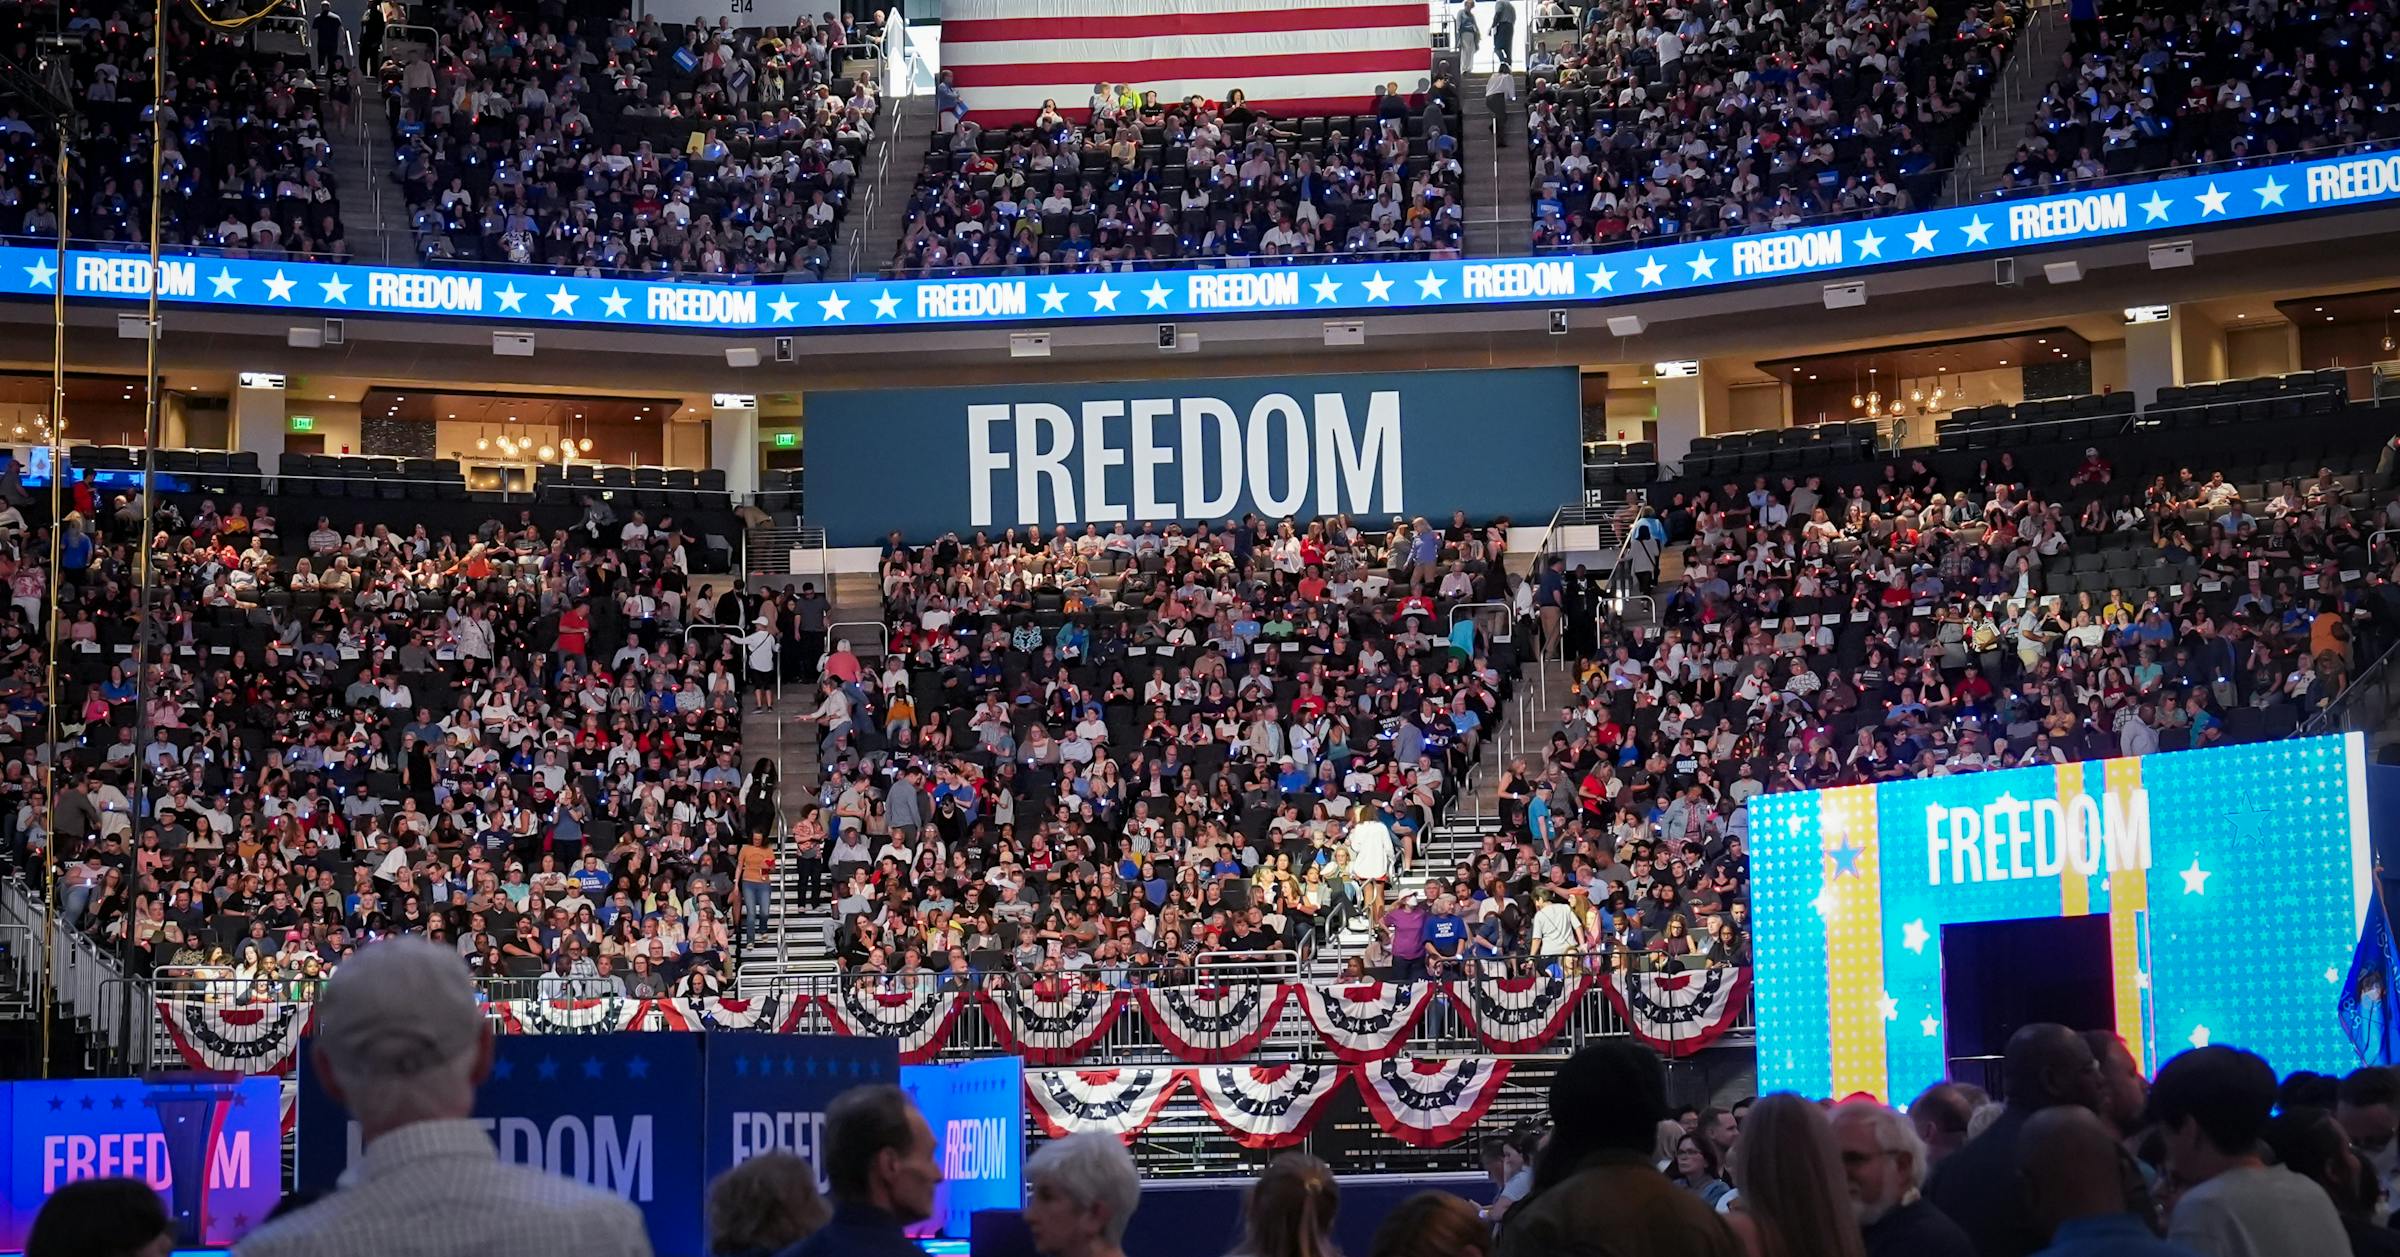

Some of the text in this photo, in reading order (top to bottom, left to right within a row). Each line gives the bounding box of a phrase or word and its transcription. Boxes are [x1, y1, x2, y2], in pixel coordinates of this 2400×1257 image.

[731, 0, 753, 13] 214
[2010, 193, 2127, 241] FREEDOM
[1733, 230, 1842, 276] FREEDOM
[76, 256, 196, 296] FREEDOM
[369, 272, 482, 311] FREEDOM
[1188, 271, 1299, 308] FREEDOM
[1463, 261, 1575, 298] FREEDOM
[648, 287, 756, 323] FREEDOM
[917, 281, 1026, 318] FREEDOM
[967, 391, 1405, 527] FREEDOM
[1926, 789, 2152, 886] FREEDOM
[44, 1131, 250, 1194] FREEDM
[732, 1111, 831, 1194] FREED
[945, 1117, 1007, 1180] FREEDOM
